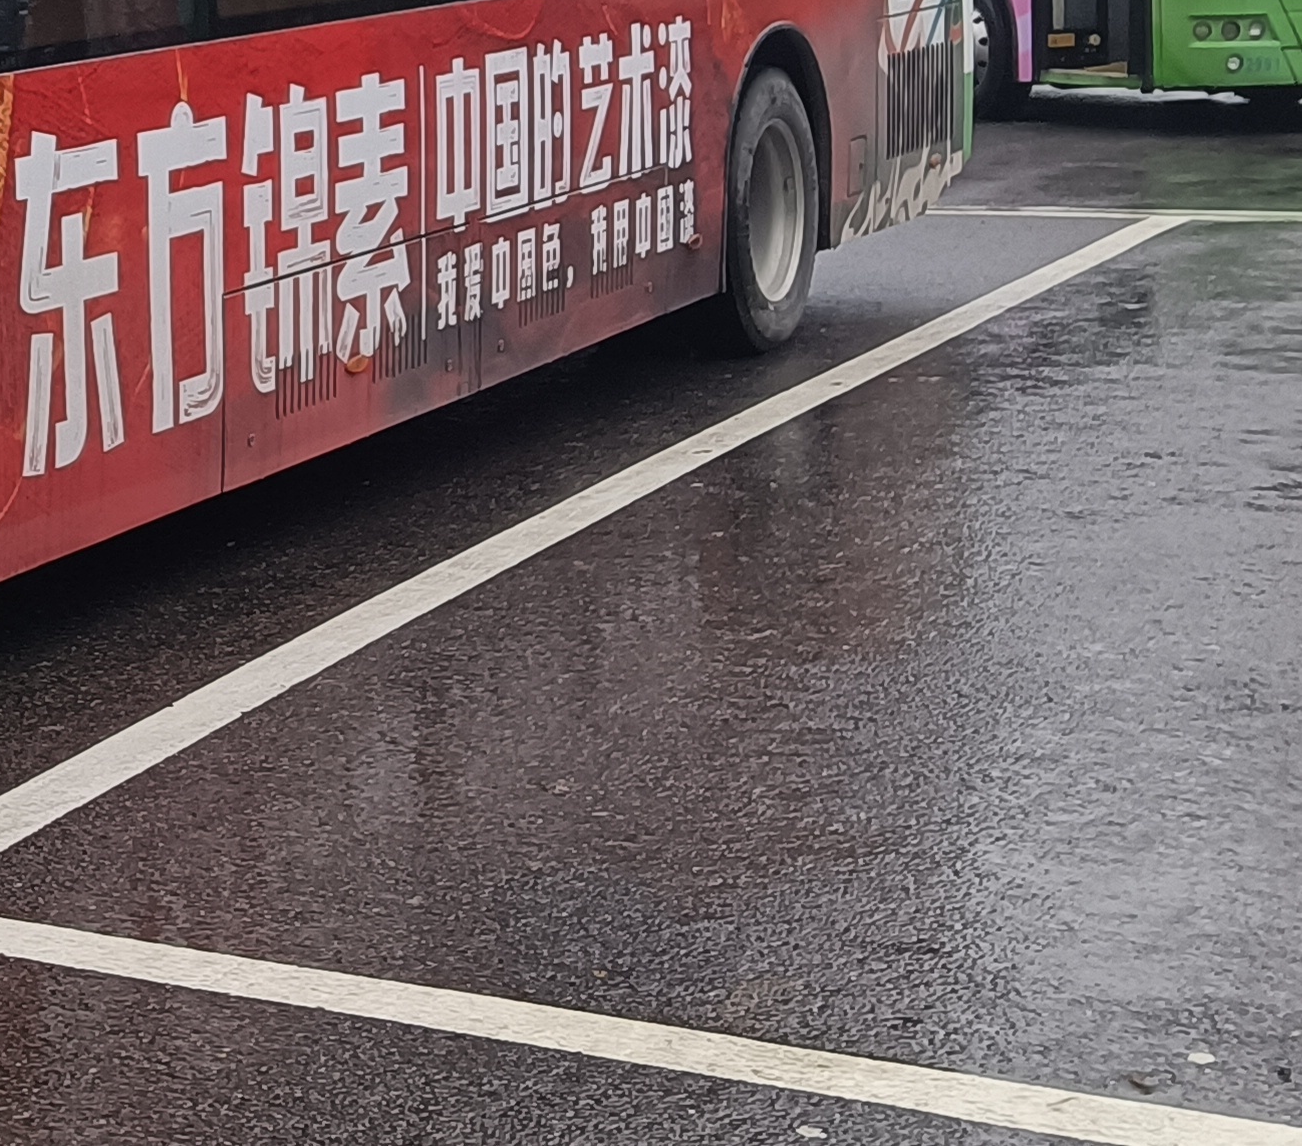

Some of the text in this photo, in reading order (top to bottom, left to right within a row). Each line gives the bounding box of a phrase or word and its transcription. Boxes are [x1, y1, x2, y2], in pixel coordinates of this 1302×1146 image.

[14, 15, 692, 477] 东方锦素 中国的艺术漆
